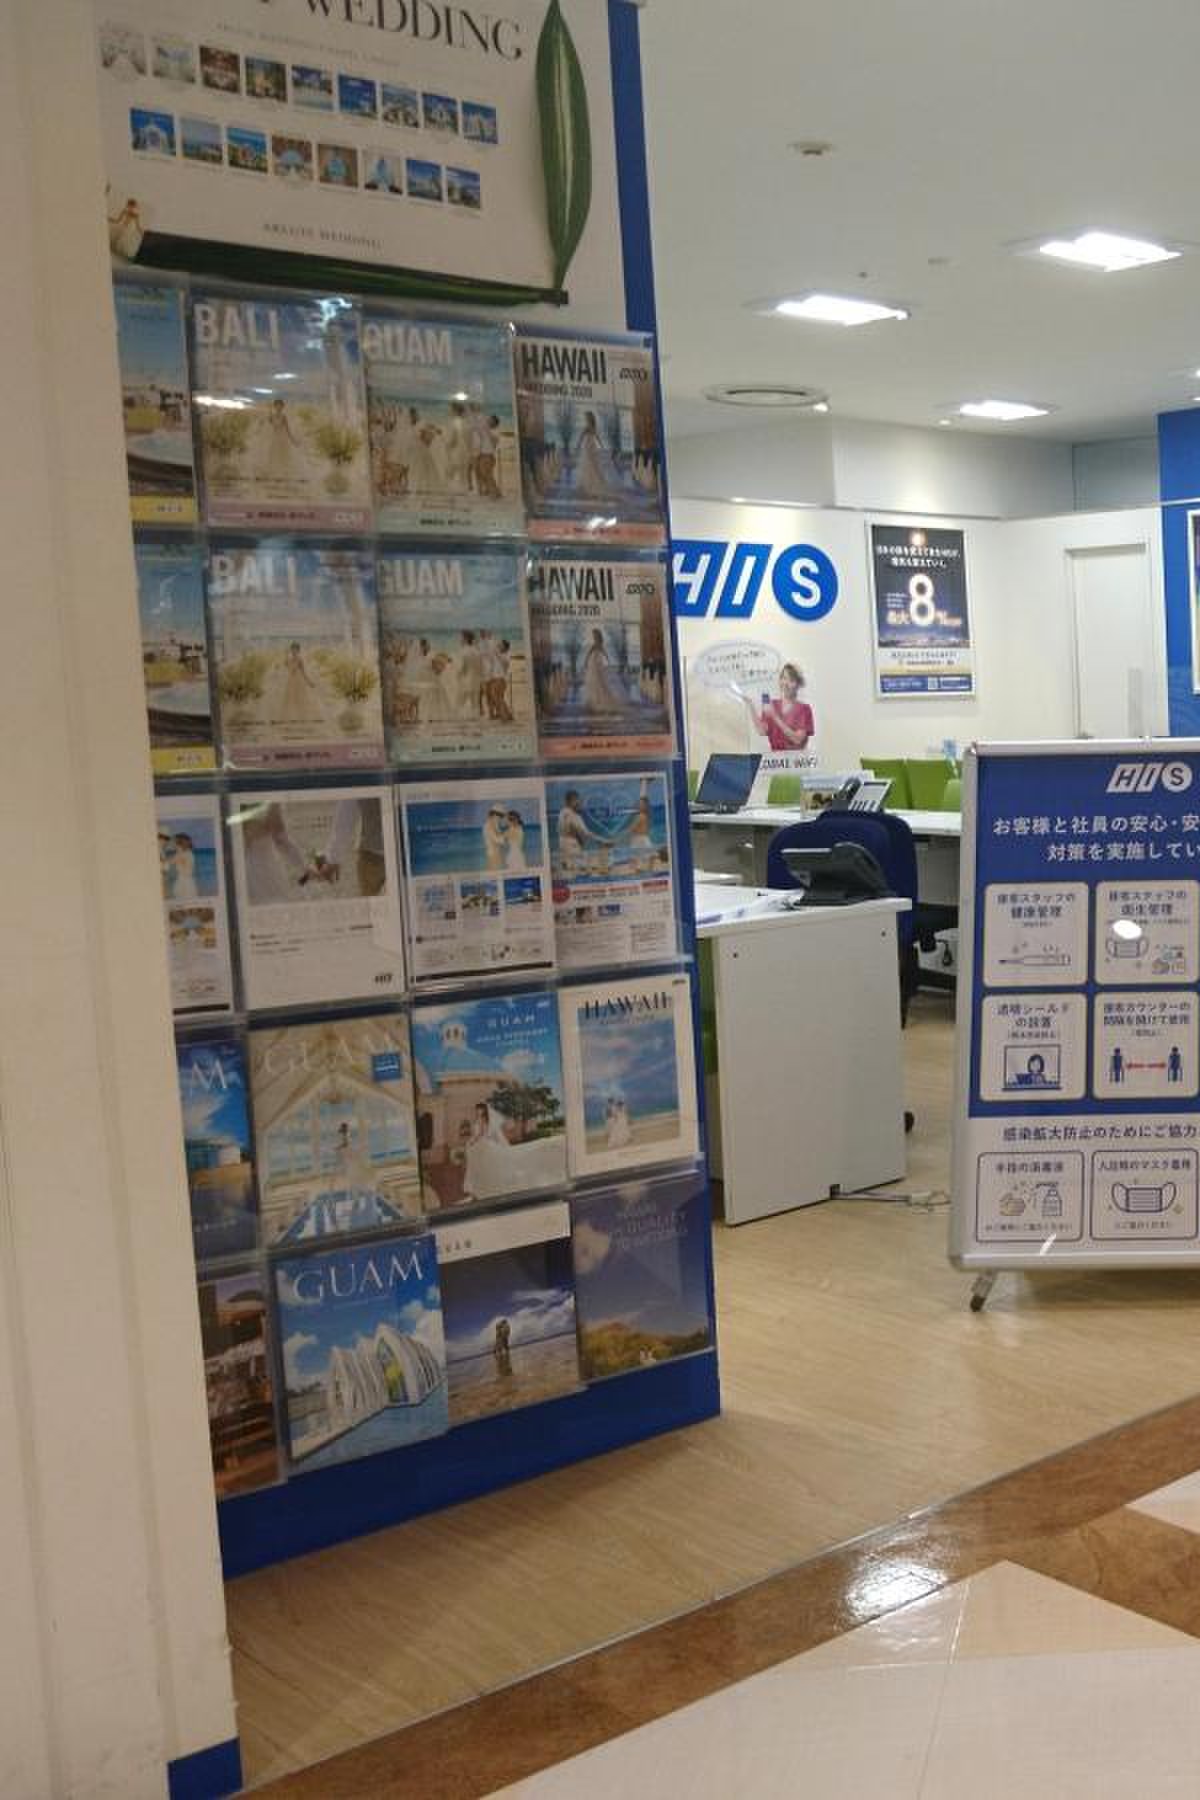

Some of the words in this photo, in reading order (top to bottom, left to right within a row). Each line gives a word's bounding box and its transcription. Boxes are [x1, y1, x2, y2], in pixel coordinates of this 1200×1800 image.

[196, 304, 280, 350] BALI
[364, 323, 451, 364] GUAM
[521, 343, 607, 384] HAWAII
[211, 553, 297, 595] BALI
[529, 567, 614, 601] HAWAII
[909, 573, 935, 626] 8
[1106, 761, 1194, 793] HIS
[292, 1250, 424, 1303] GUAM
